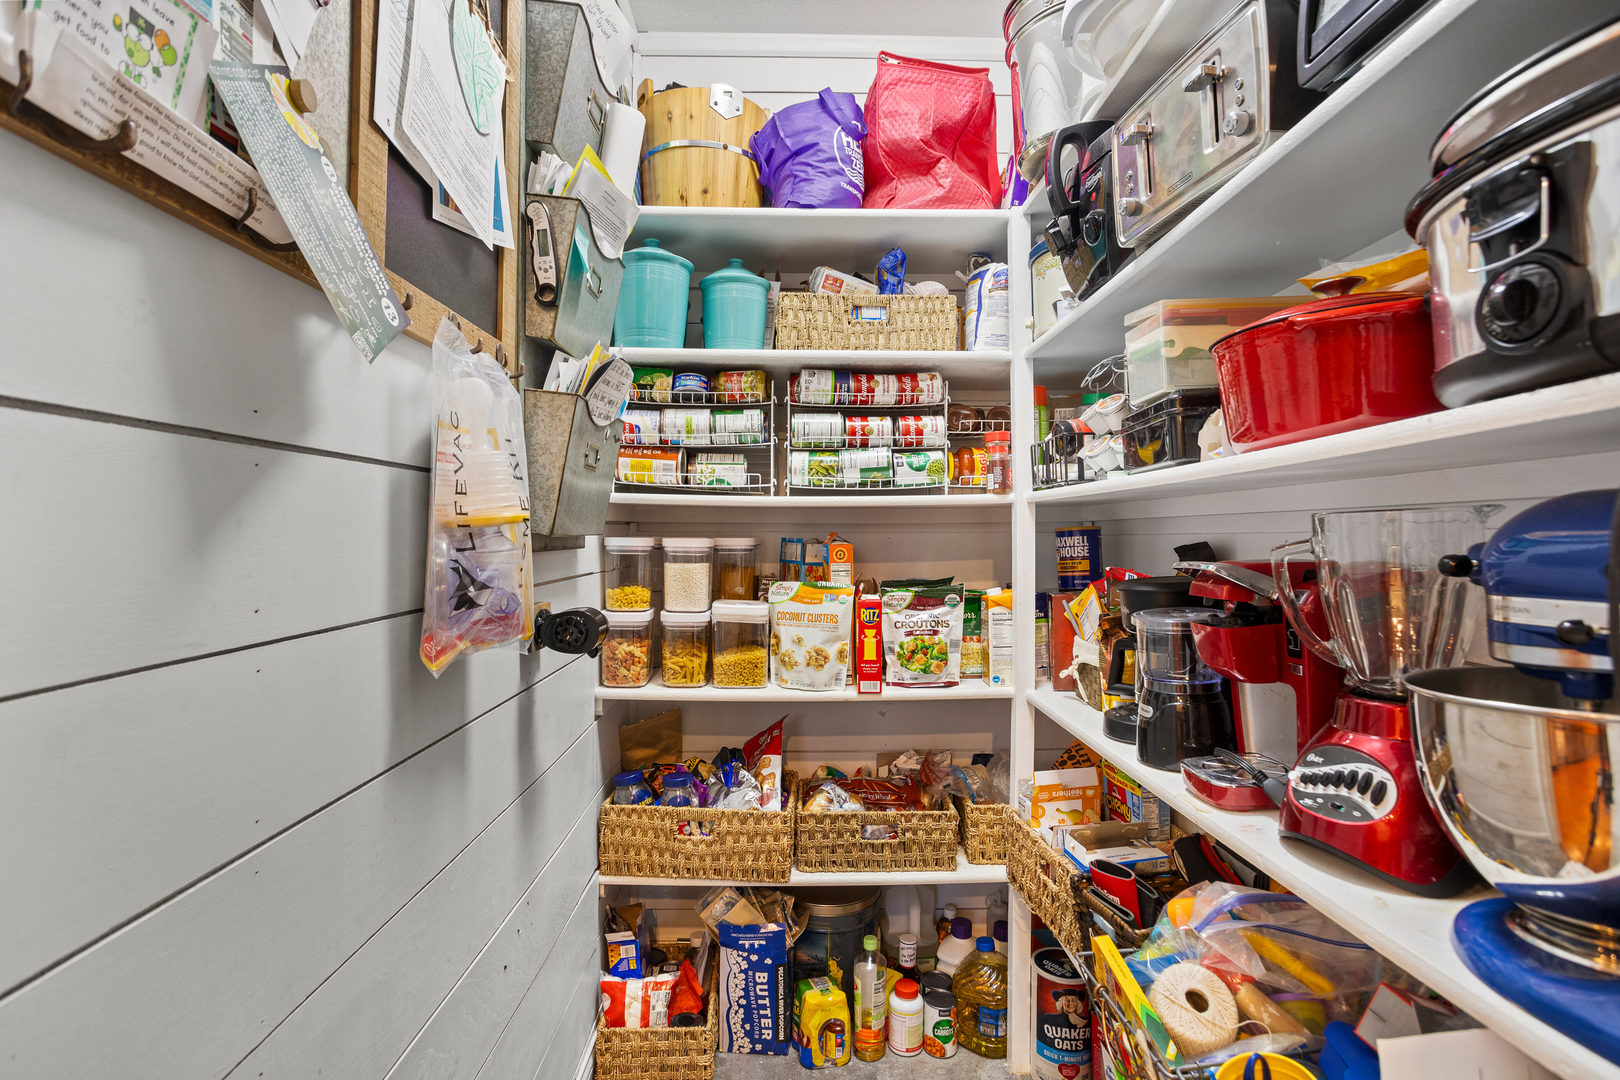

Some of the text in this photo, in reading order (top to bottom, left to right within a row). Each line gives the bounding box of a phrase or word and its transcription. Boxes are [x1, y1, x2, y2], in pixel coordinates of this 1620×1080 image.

[152, 3, 174, 26] leave
[76, 23, 97, 46] food
[100, 42, 110, 56] to
[133, 91, 153, 107] found
[152, 105, 164, 115] the
[162, 113, 186, 133] thought
[118, 94, 129, 104] for
[132, 106, 144, 115] am
[144, 113, 159, 126] with
[181, 140, 191, 148] not
[138, 138, 155, 152] good
[162, 154, 177, 166] know
[177, 164, 189, 174] that
[170, 146, 185, 159] really
[384, 302, 398, 322] 13
[450, 411, 476, 552] LIFEVAC
[1056, 536, 1089, 547] AXWELL
[1060, 546, 1089, 557] HOUSE
[776, 611, 838, 624] COCONUT CLUSTERS
[861, 608, 879, 621] RITZ
[894, 620, 950, 629] CROUTONS
[1042, 960, 1072, 977] QUAKER
[748, 970, 756, 1008] MICROWAVE
[755, 972, 773, 1040] BUTTER
[1044, 1024, 1091, 1039] QUAKER
[1054, 1039, 1084, 1051] OATS
[1044, 1050, 1058, 1060] QUICK
